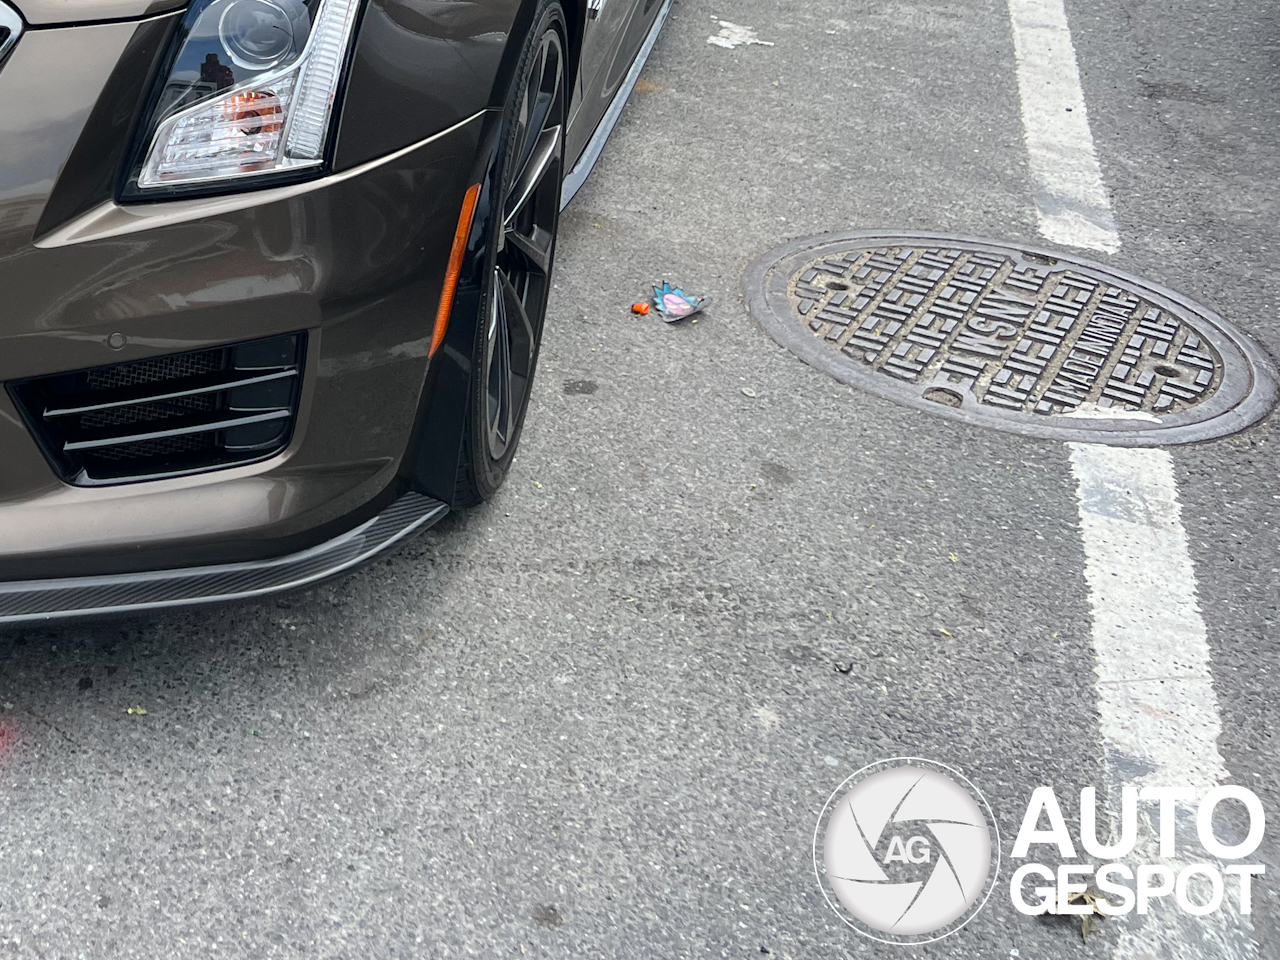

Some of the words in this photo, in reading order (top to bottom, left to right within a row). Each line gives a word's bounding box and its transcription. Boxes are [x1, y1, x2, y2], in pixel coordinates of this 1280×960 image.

[1080, 305, 1133, 342] INDIA
[1074, 336, 1114, 356] IN
[1049, 349, 1106, 399] MADE
